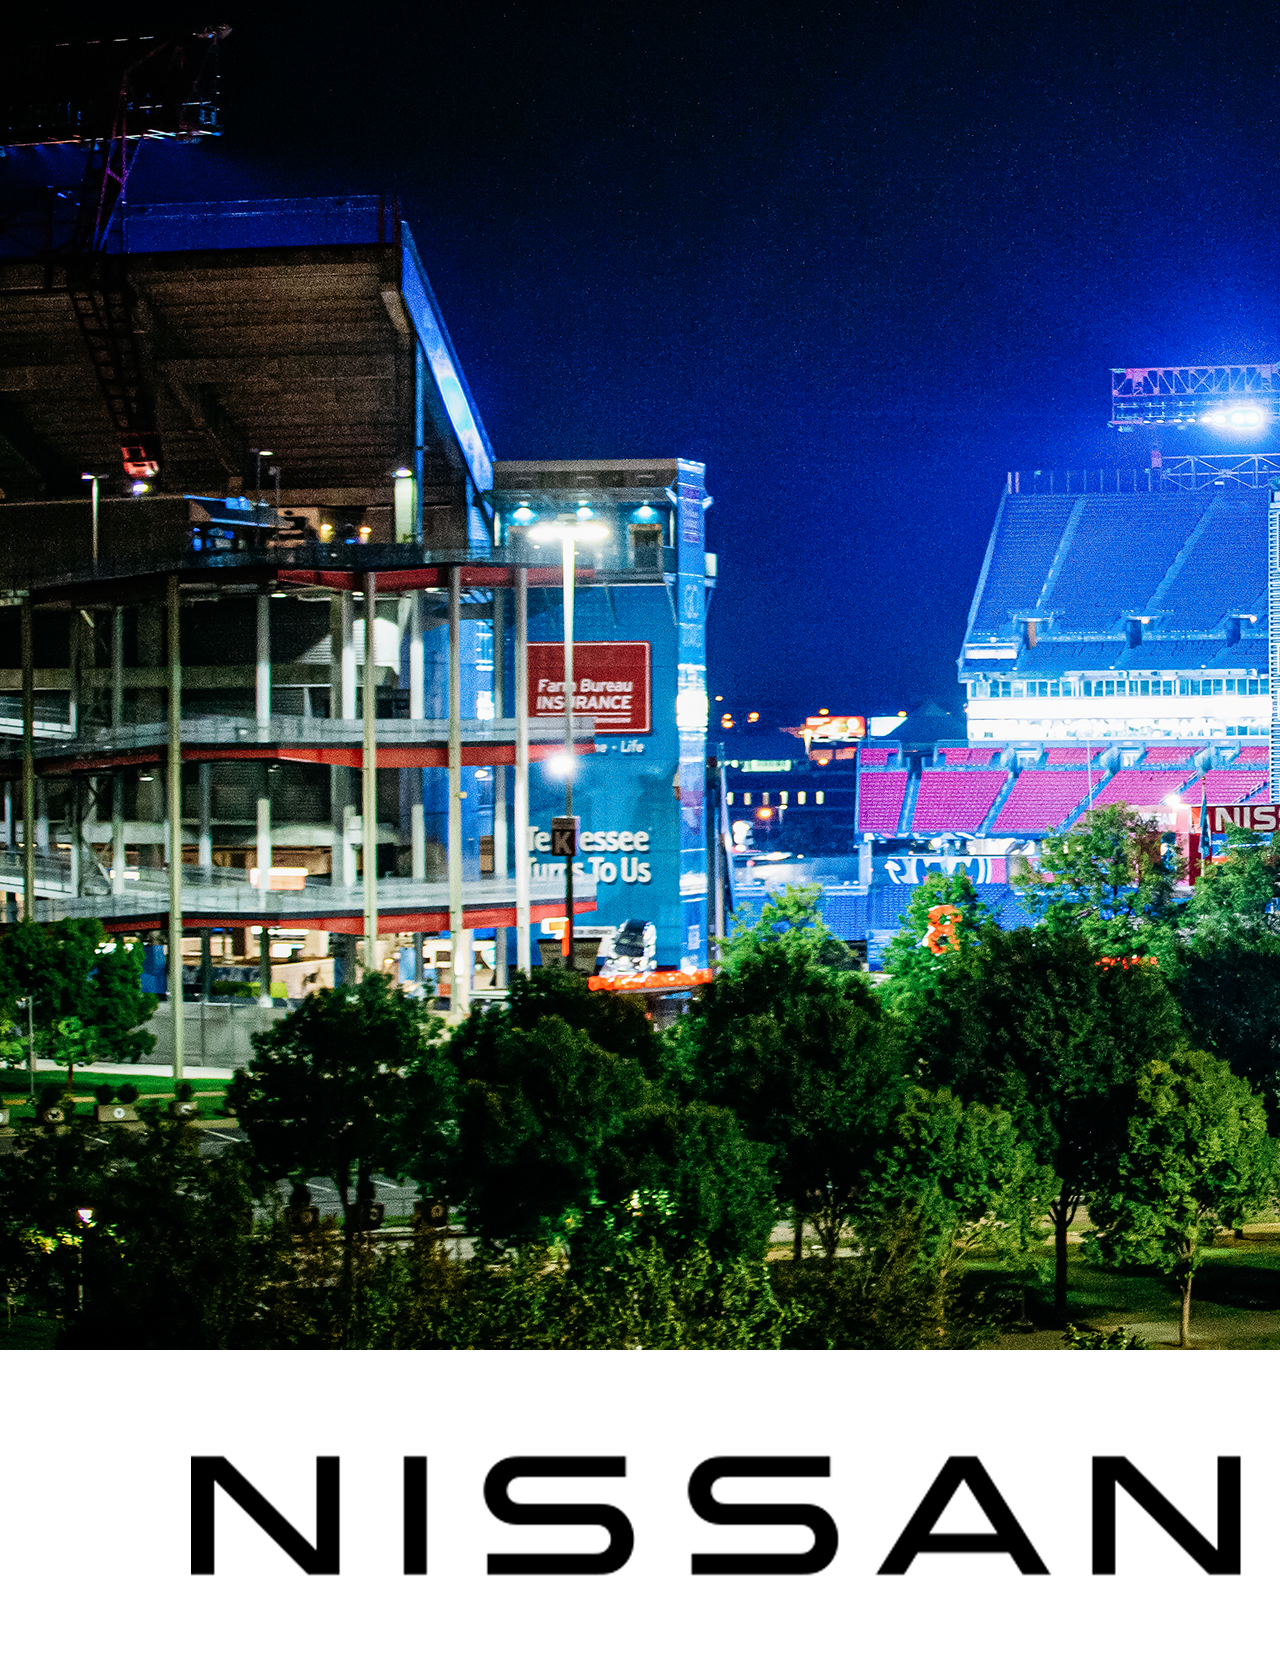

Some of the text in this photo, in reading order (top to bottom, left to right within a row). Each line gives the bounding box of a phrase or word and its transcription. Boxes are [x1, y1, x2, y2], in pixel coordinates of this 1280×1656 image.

[580, 679, 633, 693] Bureau
[527, 826, 650, 852] Teessee
[554, 831, 573, 855] K
[587, 857, 618, 883] To
[620, 857, 652, 883] Us
